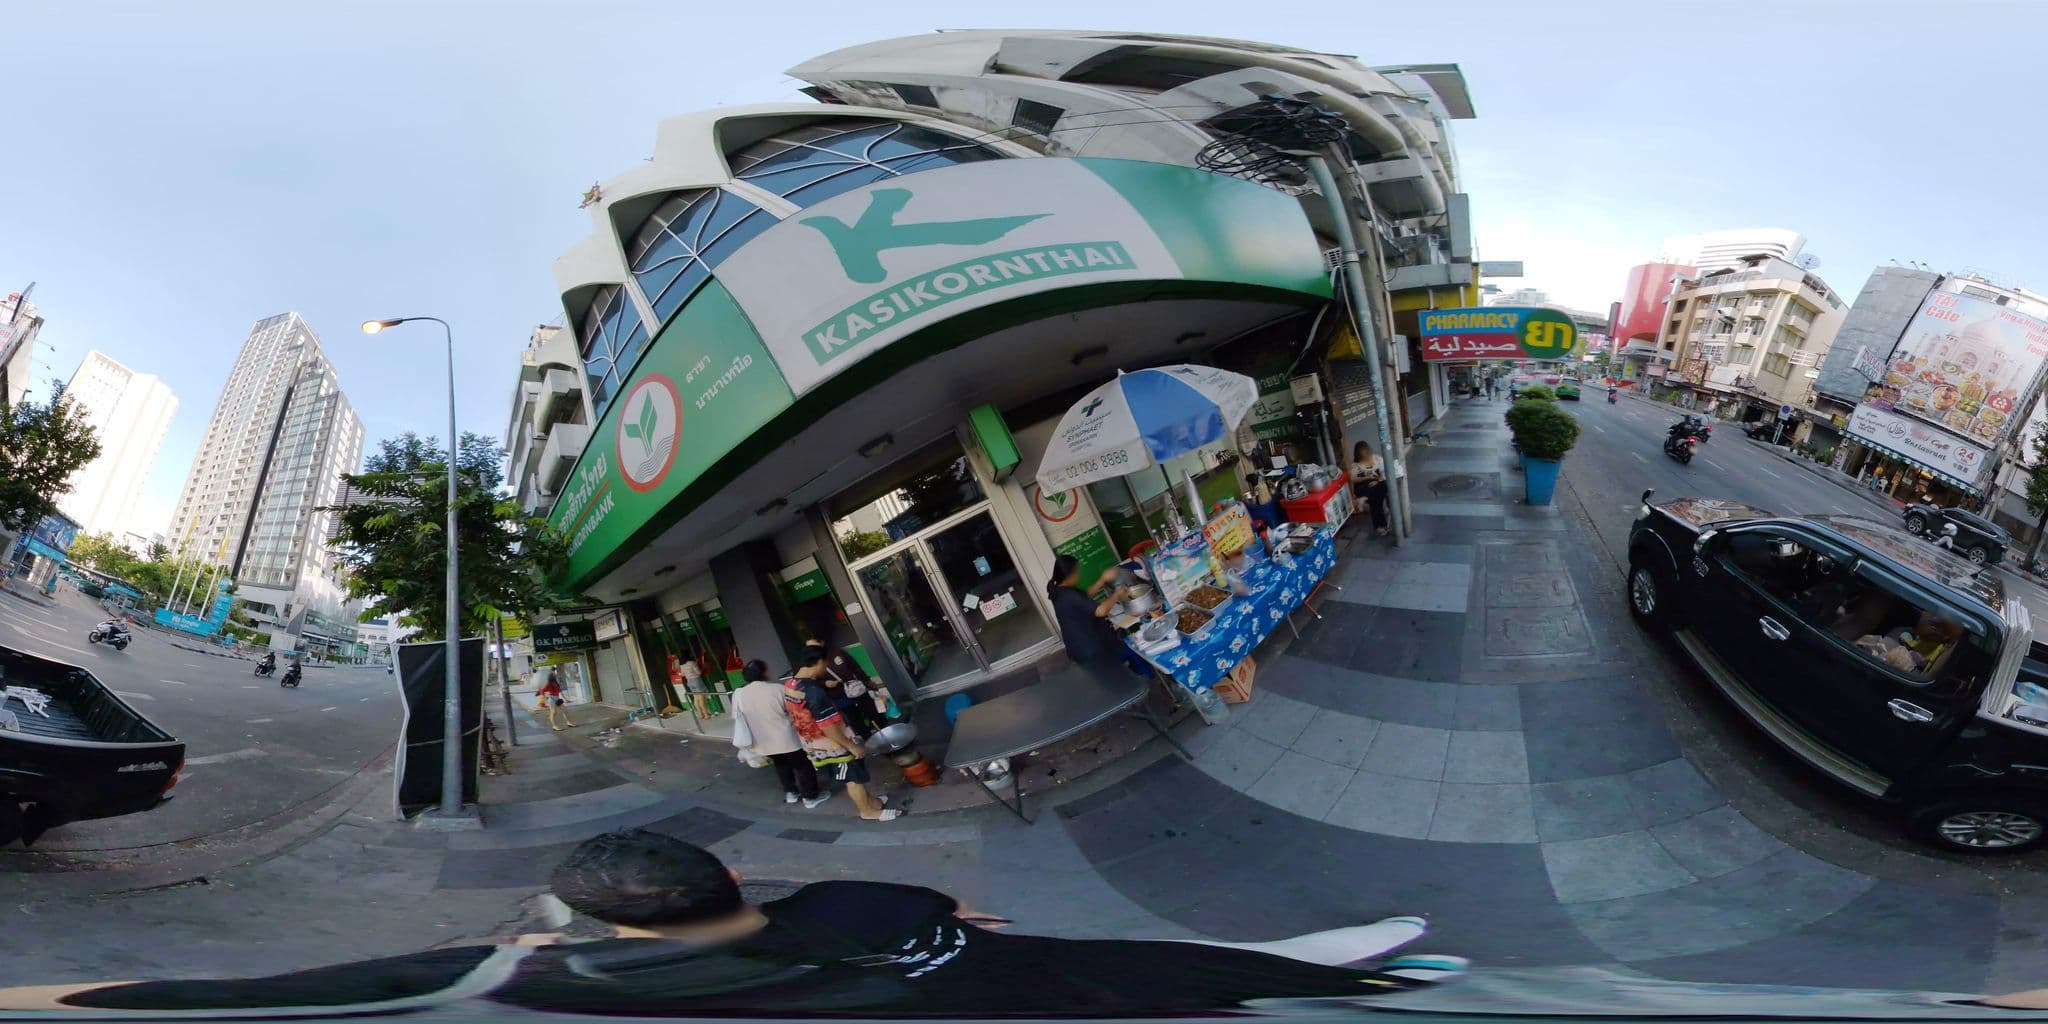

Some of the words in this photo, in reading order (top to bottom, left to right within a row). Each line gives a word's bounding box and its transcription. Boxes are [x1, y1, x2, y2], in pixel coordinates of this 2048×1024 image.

[815, 246, 1123, 354] KASIKORNTHAI
[1426, 313, 1519, 331] PHARMACY
[1525, 320, 1572, 349] ยา
[1065, 466, 1079, 479] 02
[1081, 458, 1099, 475] 006
[1101, 450, 1129, 468] 8888
[1958, 448, 1976, 462] 24
